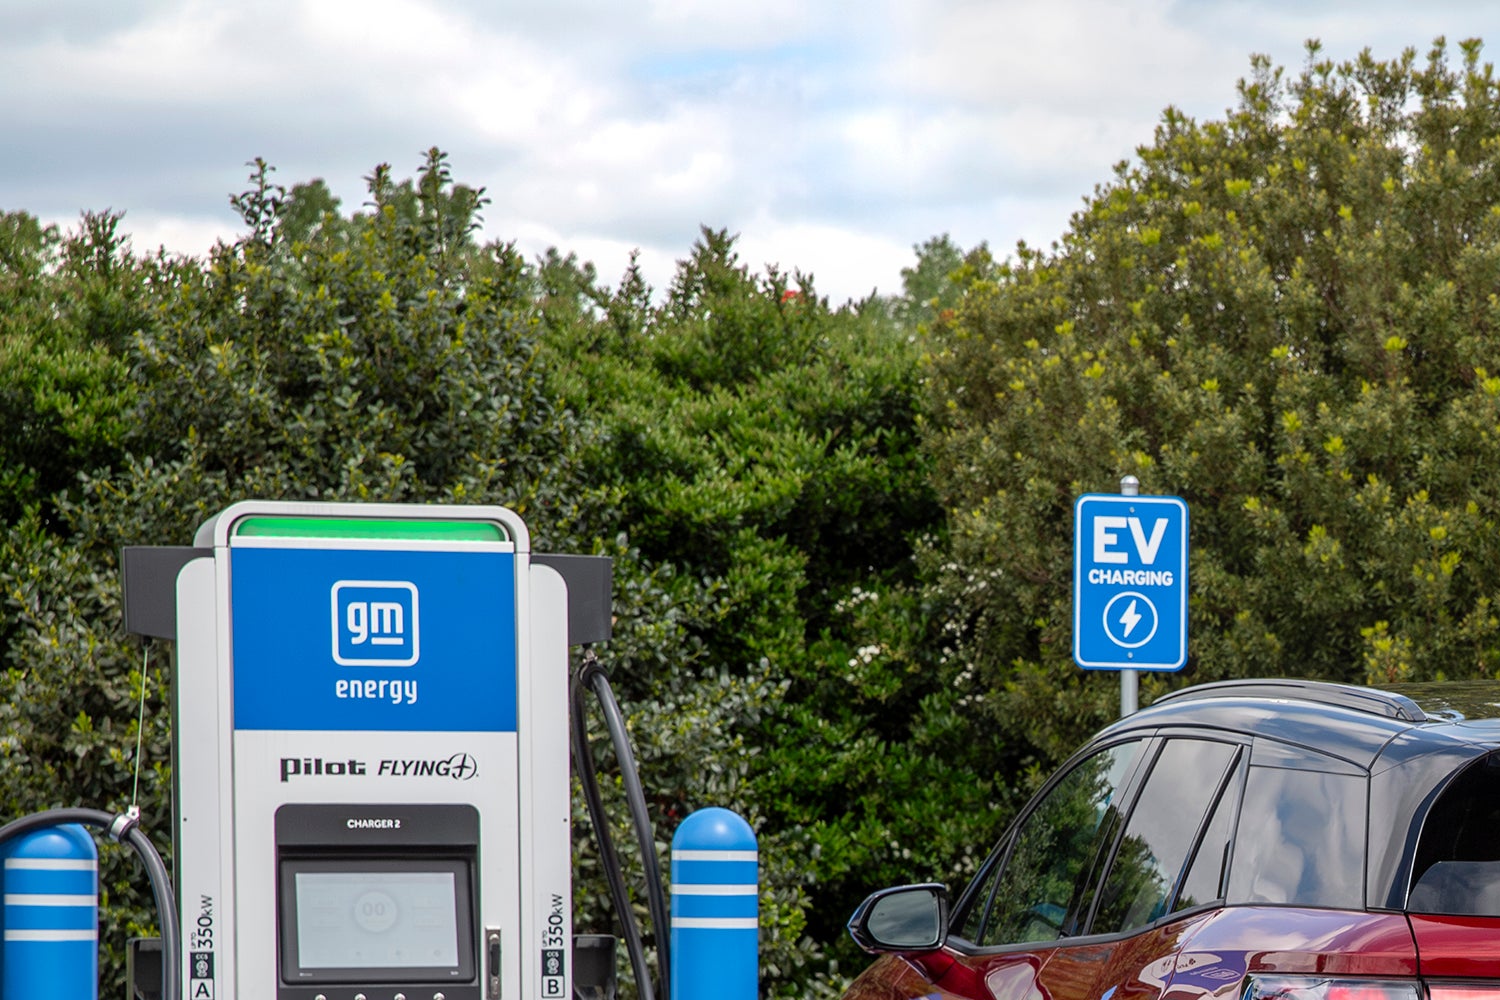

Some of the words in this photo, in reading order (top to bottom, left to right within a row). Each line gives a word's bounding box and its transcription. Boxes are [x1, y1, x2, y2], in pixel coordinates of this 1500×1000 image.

[1093, 515, 1169, 565] EV
[1088, 569, 1173, 586] CHARGING
[346, 602, 404, 645] gm
[335, 679, 418, 705] energy
[346, 819, 393, 829] CHARGER
[394, 819, 401, 828] 2
[197, 894, 213, 949] 350kW
[547, 893, 564, 946] 350kW
[194, 982, 210, 998] A
[547, 979, 559, 994] B
